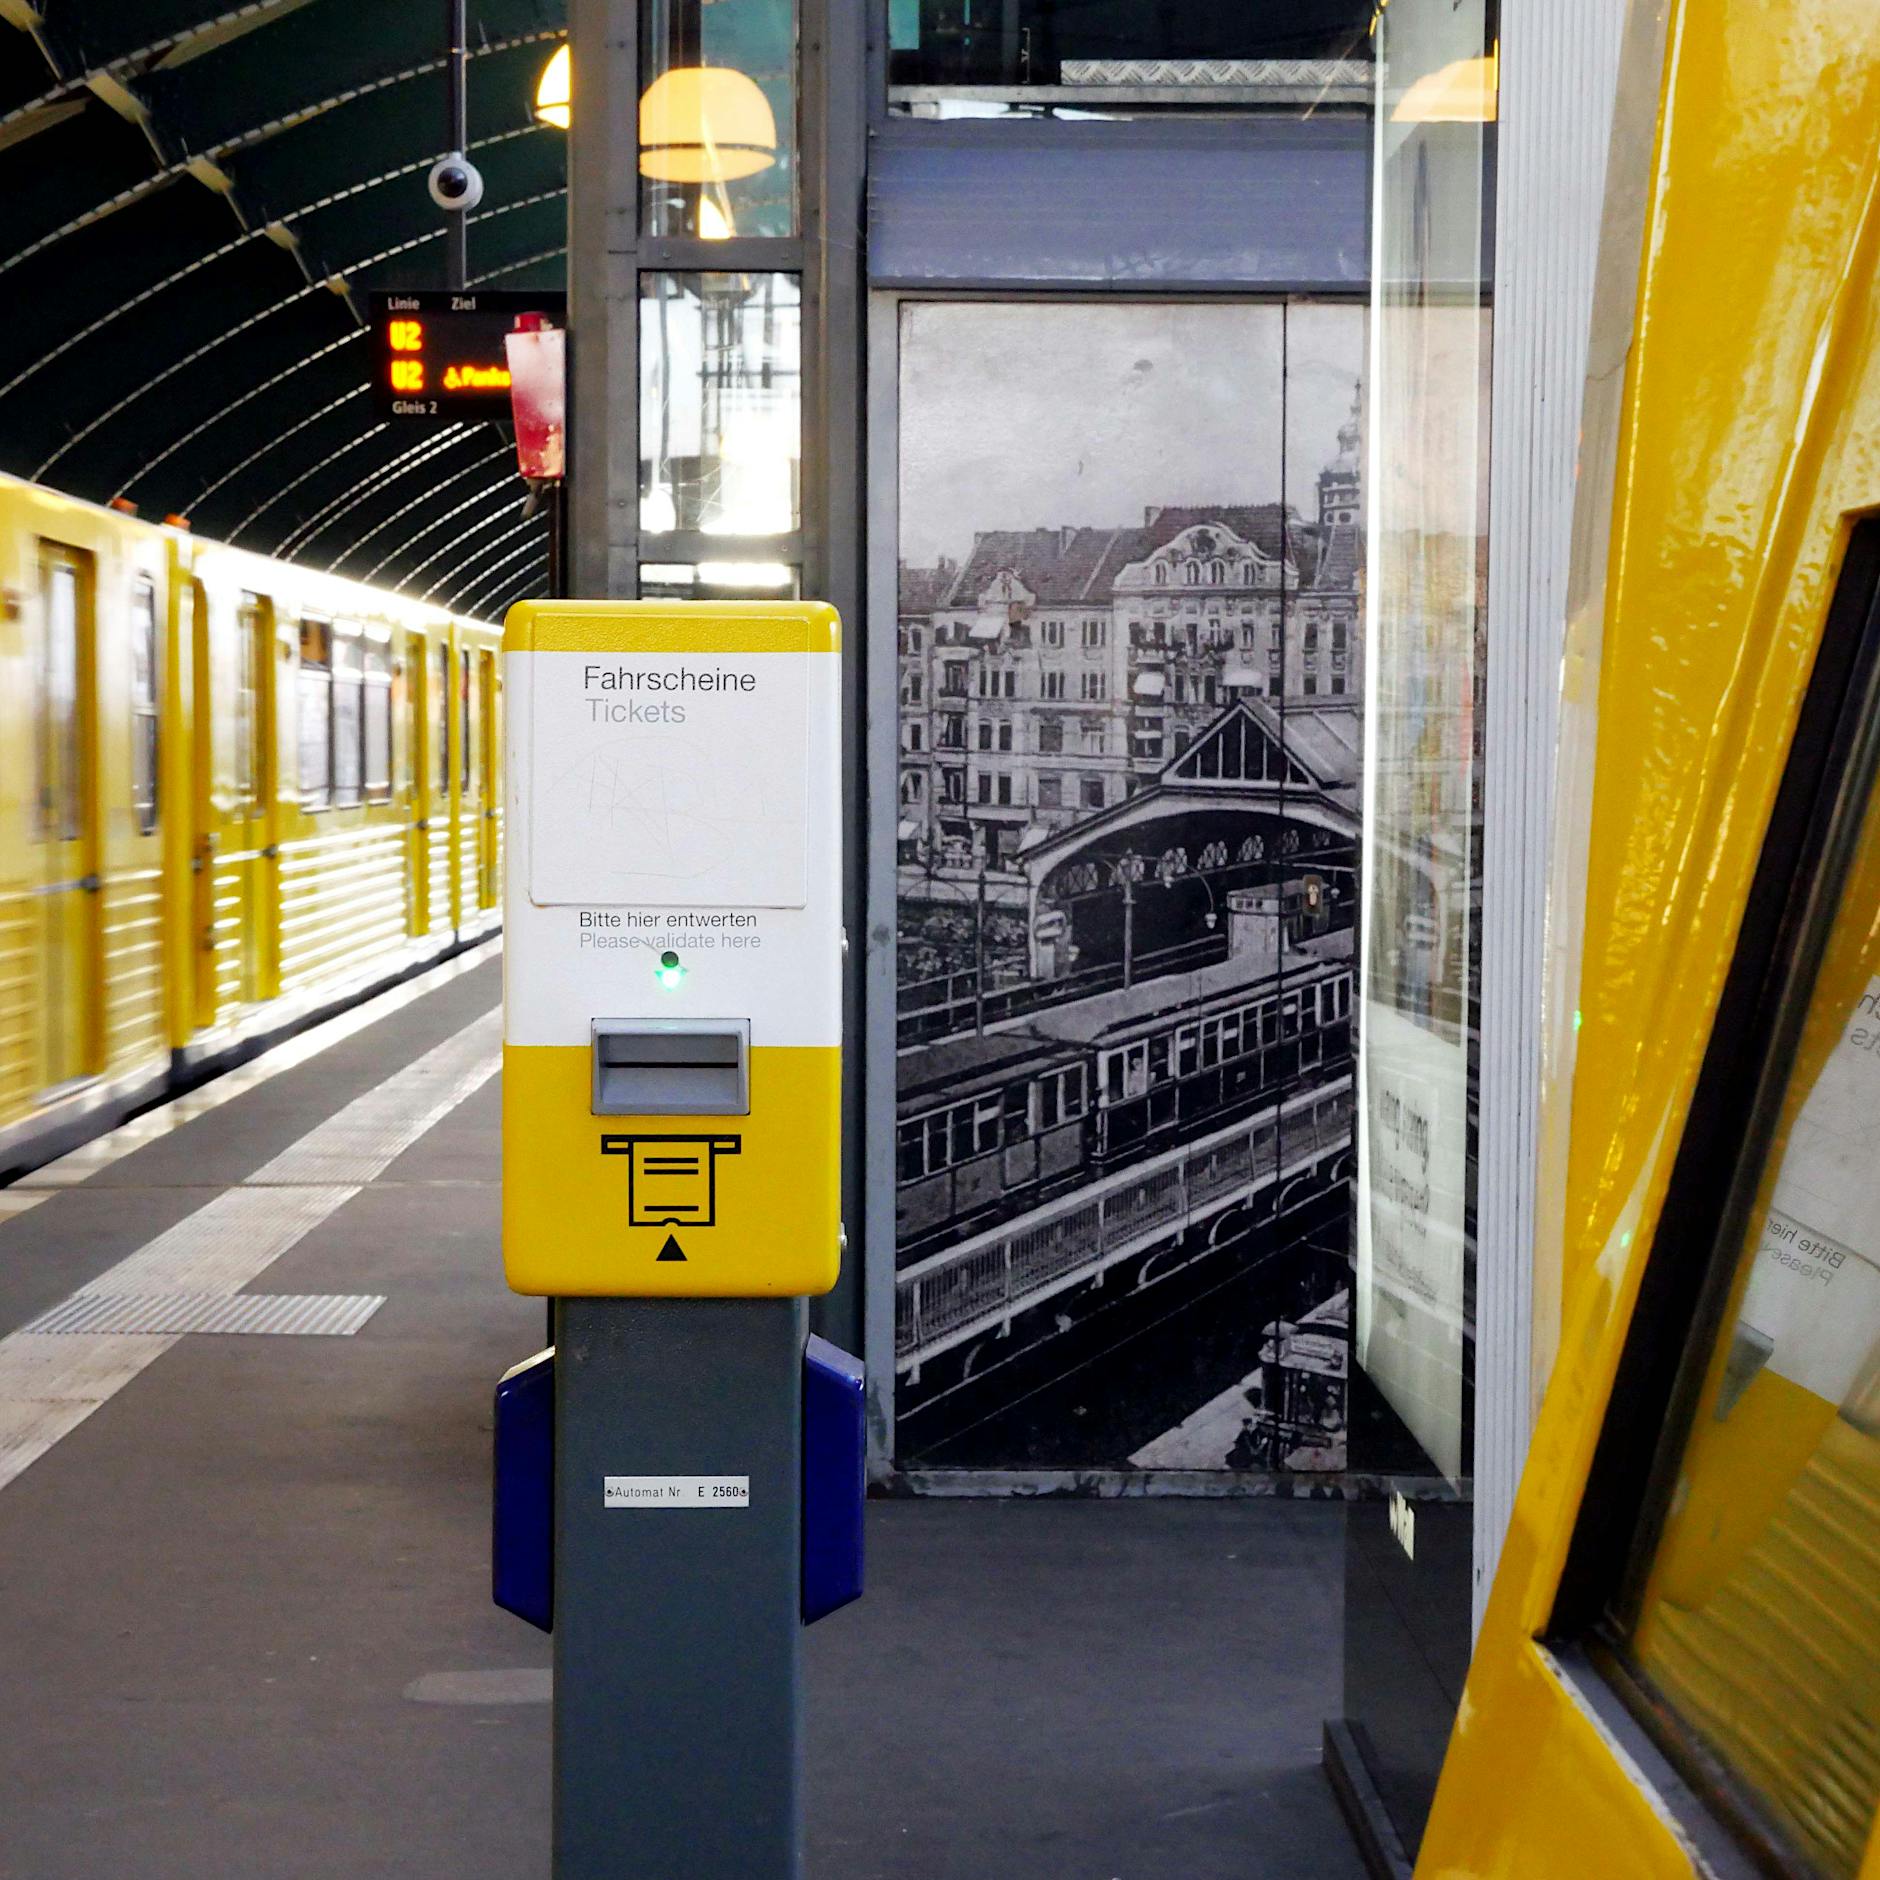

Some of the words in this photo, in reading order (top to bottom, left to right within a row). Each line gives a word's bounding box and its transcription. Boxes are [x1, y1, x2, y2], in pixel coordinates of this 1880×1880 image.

[388, 297, 420, 310] Linie
[451, 297, 476, 310] Ziel
[389, 321, 422, 351] U2
[390, 360, 424, 390] U2
[392, 400, 426, 415] Gleis
[429, 401, 437, 414] 2
[584, 665, 756, 692] Fahrscheine
[586, 698, 686, 723] Tickets
[580, 911, 621, 928] Bitte
[627, 911, 660, 928] hier
[666, 913, 757, 928] entwerten
[580, 932, 641, 949] Please
[645, 932, 715, 949] validate
[721, 932, 761, 949] here
[615, 1486, 663, 1498] Automat
[698, 1486, 705, 1498] E
[712, 1486, 739, 1498] 2560
